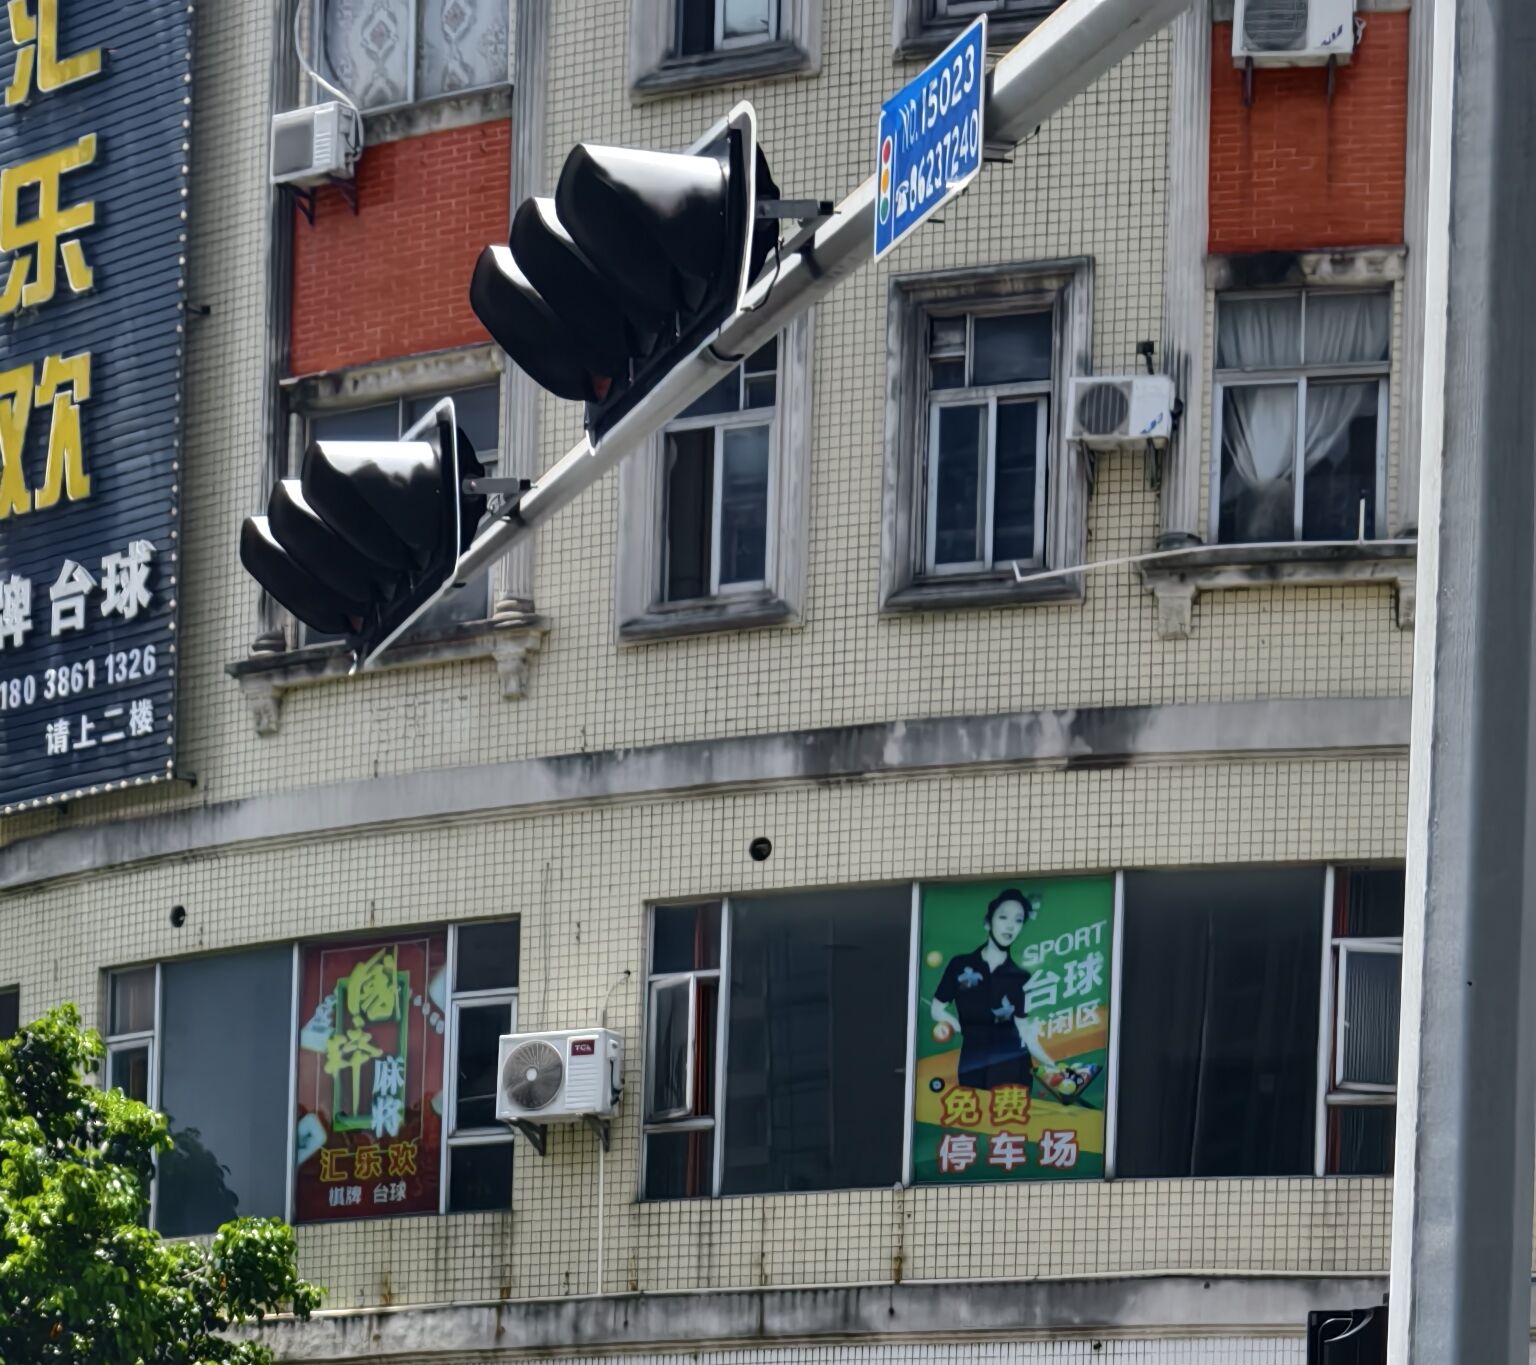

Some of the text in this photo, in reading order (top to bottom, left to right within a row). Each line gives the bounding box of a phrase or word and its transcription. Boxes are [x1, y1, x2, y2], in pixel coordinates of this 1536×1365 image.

[899, 44, 975, 153] NO. 15023
[910, 108, 979, 212] 86237240
[49, 538, 157, 638] 台球
[43, 658, 96, 700] 3861
[104, 644, 157, 685] 1326
[46, 698, 154, 756] 请上二楼
[1022, 920, 1107, 967] SPORT
[1022, 951, 1104, 1014] 台球
[371, 1055, 404, 1138] 麻将
[941, 1085, 1031, 1127] 免费
[319, 1143, 418, 1182] 汇乐欢
[938, 1131, 1079, 1172] 停车场
[328, 1182, 407, 1207] 棋牌 台球
